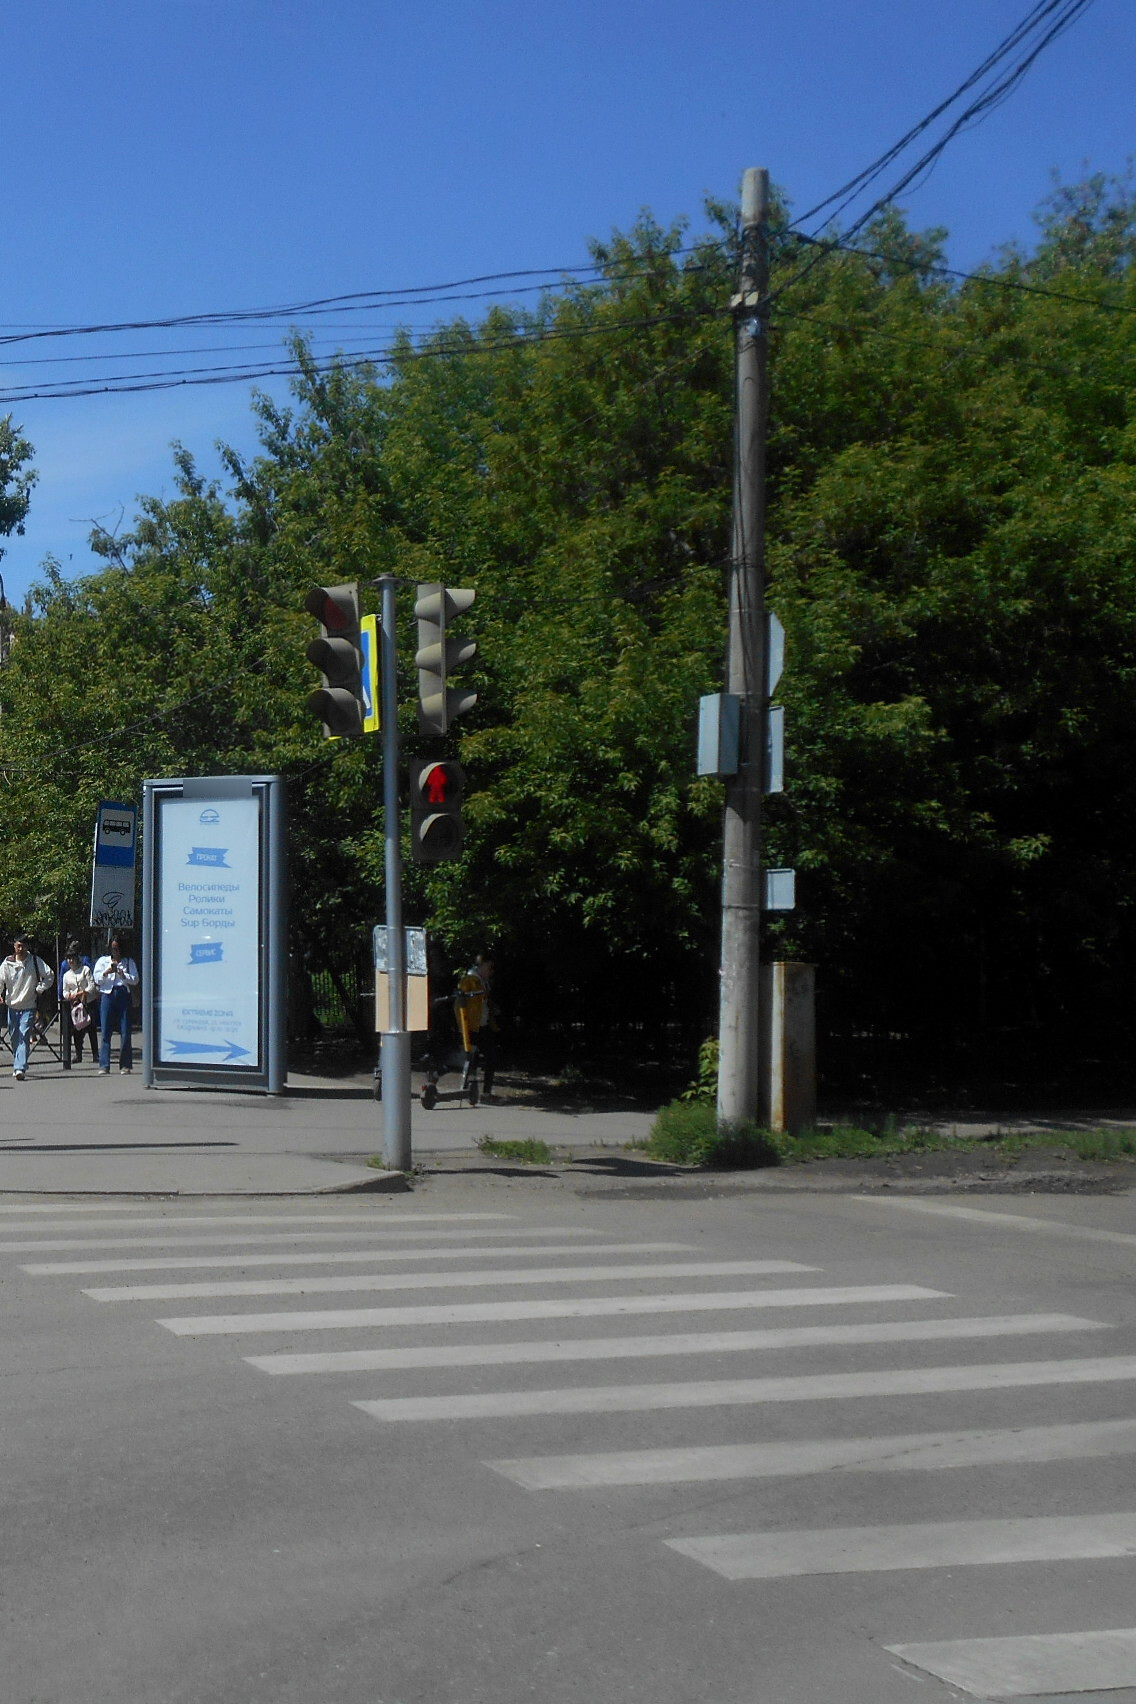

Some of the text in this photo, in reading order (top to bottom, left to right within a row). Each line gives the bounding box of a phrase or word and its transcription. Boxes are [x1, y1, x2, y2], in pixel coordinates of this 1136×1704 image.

[178, 882, 240, 892] Велосипеды
[189, 894, 225, 903] Ролики
[183, 906, 233, 915] Самокаты
[181, 918, 200, 928] Sup
